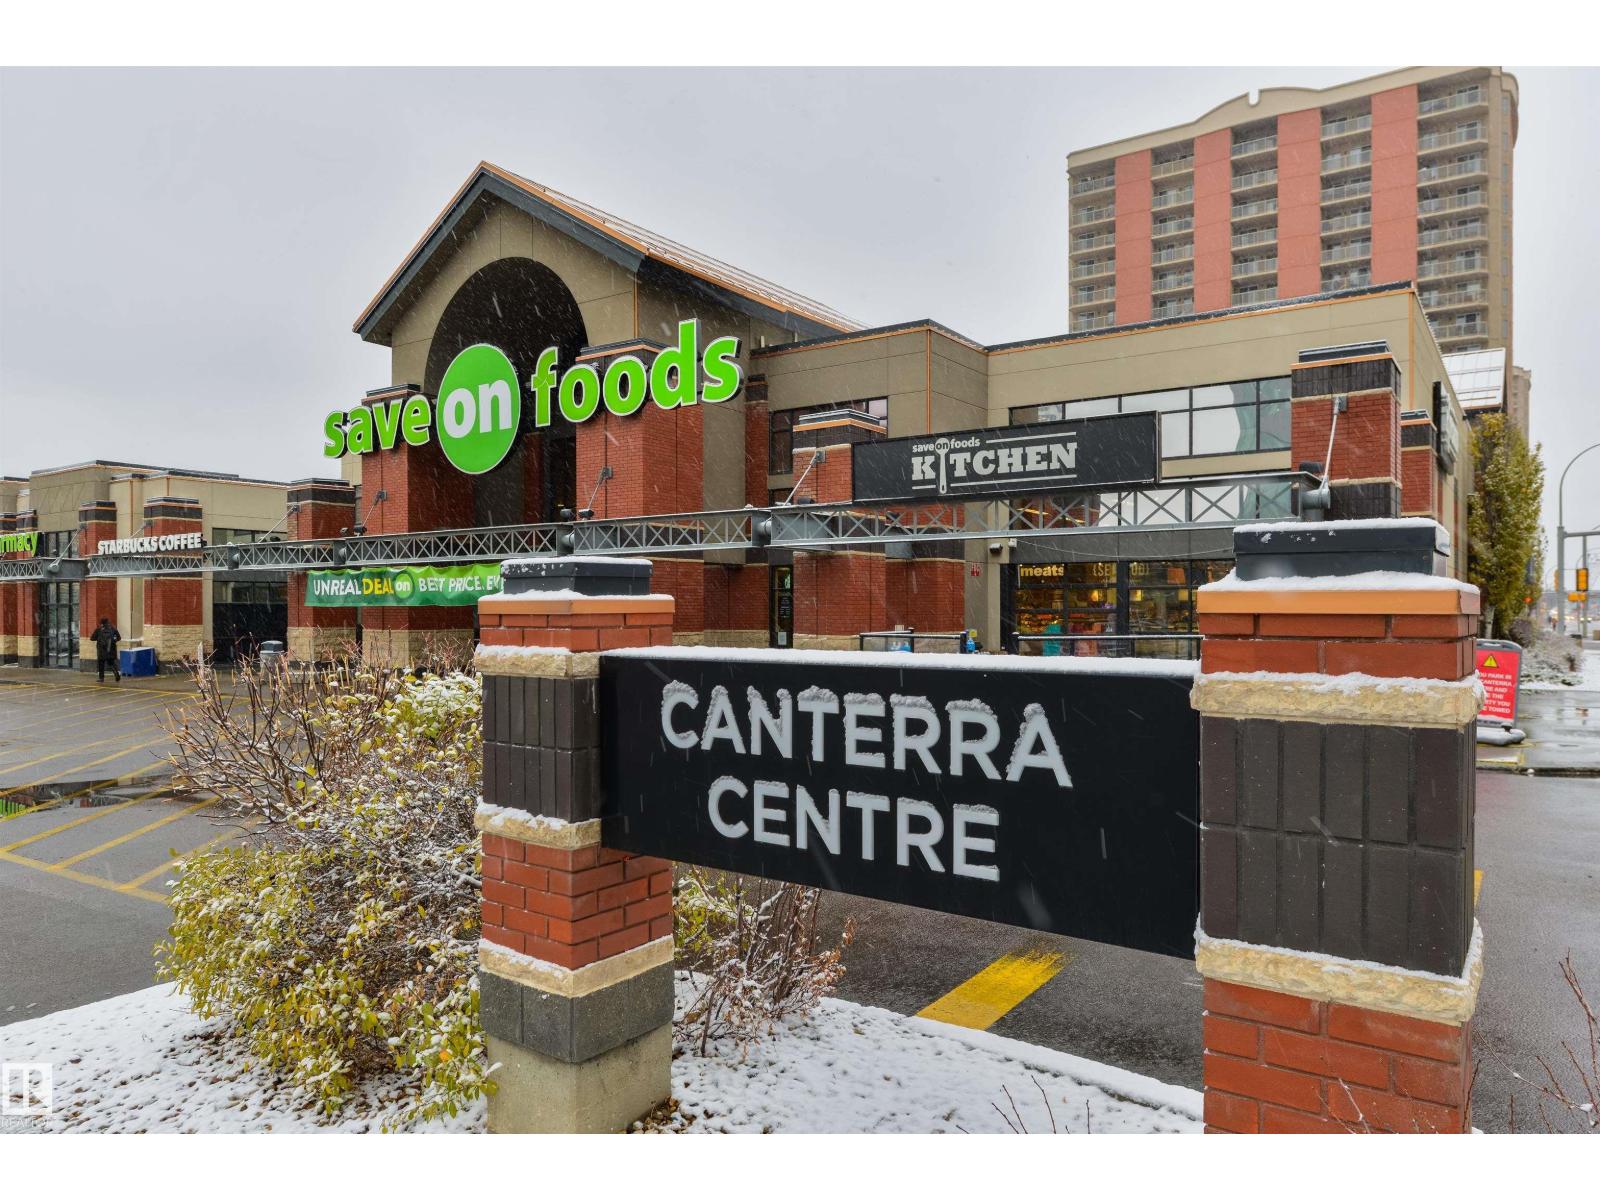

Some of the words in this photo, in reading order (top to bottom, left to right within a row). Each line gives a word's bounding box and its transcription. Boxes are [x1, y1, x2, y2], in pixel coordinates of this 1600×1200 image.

[324, 394, 431, 458] save
[443, 378, 513, 439] on
[530, 318, 742, 427] foods
[912, 442, 935, 453] save
[936, 441, 949, 451] on
[950, 436, 980, 449] foods
[911, 442, 1077, 482] KITCHEN
[97, 536, 158, 555] STARBUCKS
[159, 532, 202, 551] COFFEE
[1020, 564, 1064, 577] meats
[313, 579, 362, 596] UNREAL
[362, 578, 394, 595] DEAL
[395, 581, 411, 592] on
[418, 578, 446, 592] BEST
[662, 680, 1074, 789] CANTERRA
[708, 775, 1000, 882] CENTRE
